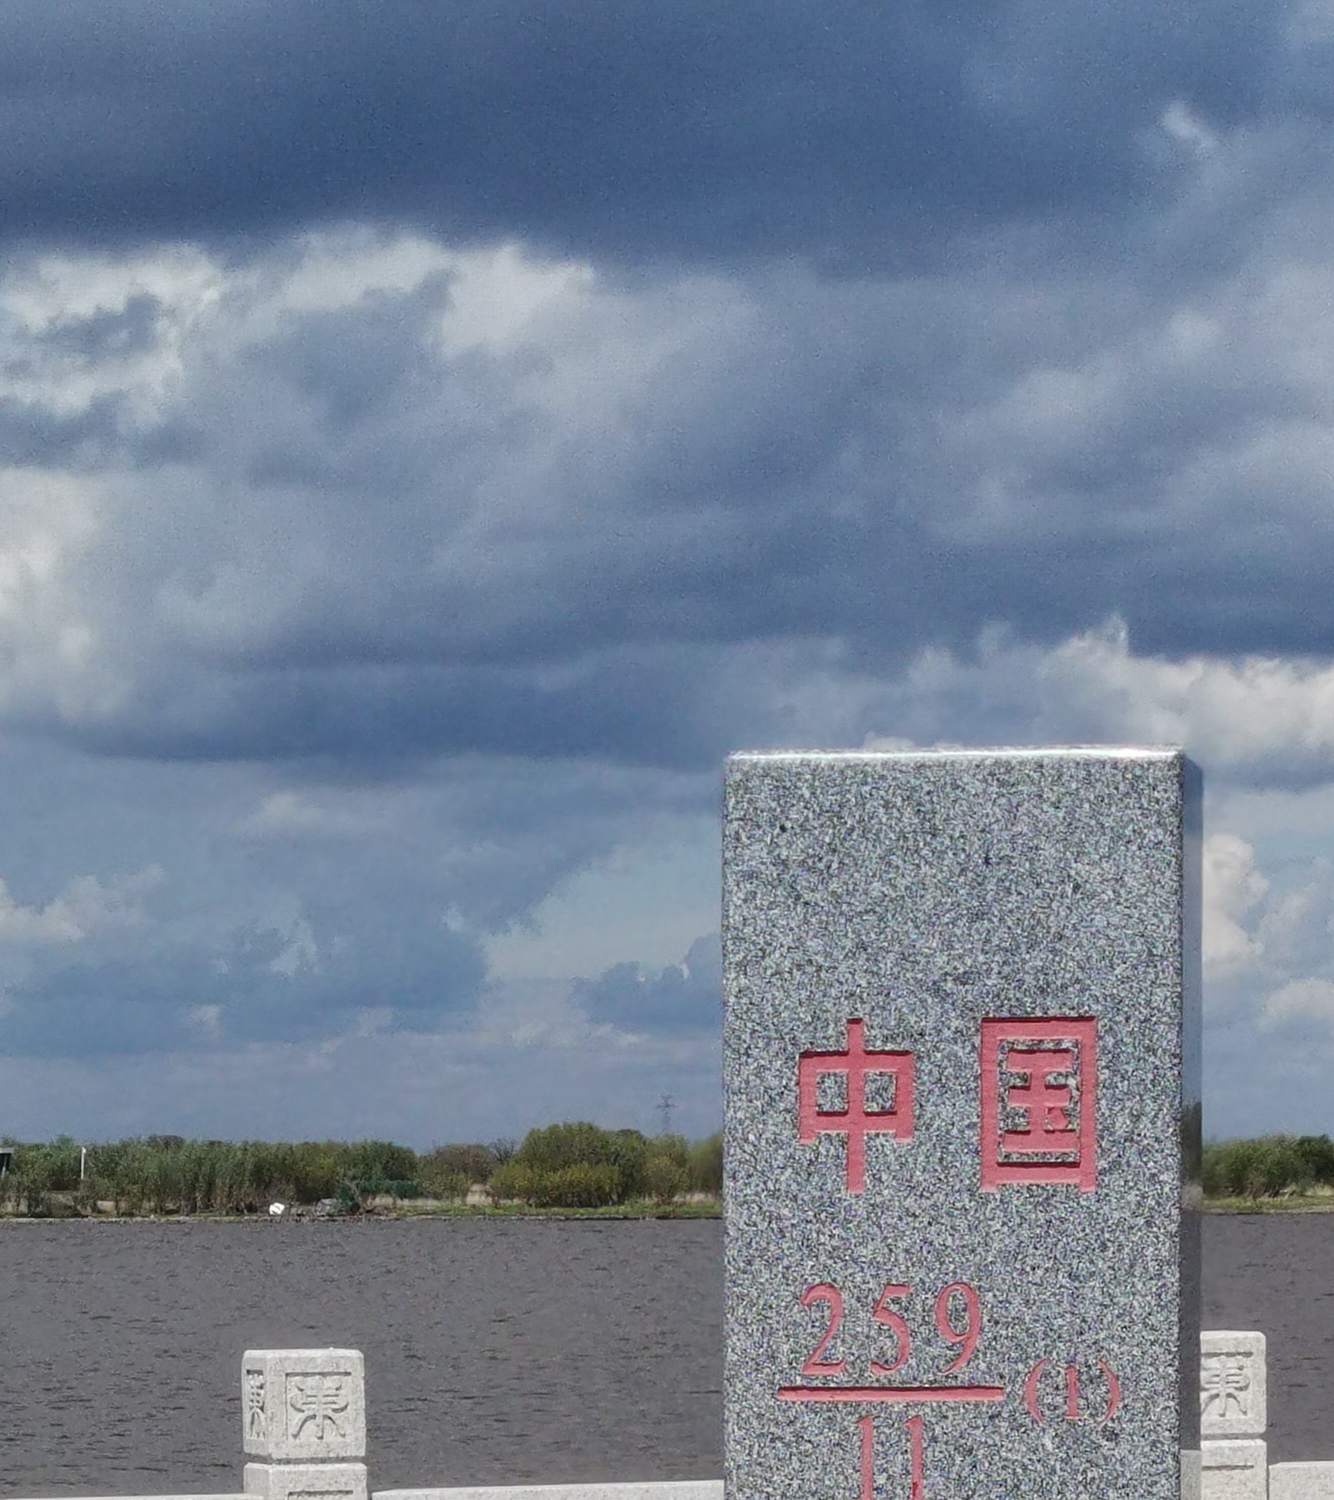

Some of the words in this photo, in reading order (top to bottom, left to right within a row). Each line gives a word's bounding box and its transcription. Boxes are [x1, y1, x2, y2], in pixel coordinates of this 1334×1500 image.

[797, 1016, 1097, 1193] 中国
[798, 1281, 981, 1376] 259
[1022, 1356, 1121, 1426] (1)
